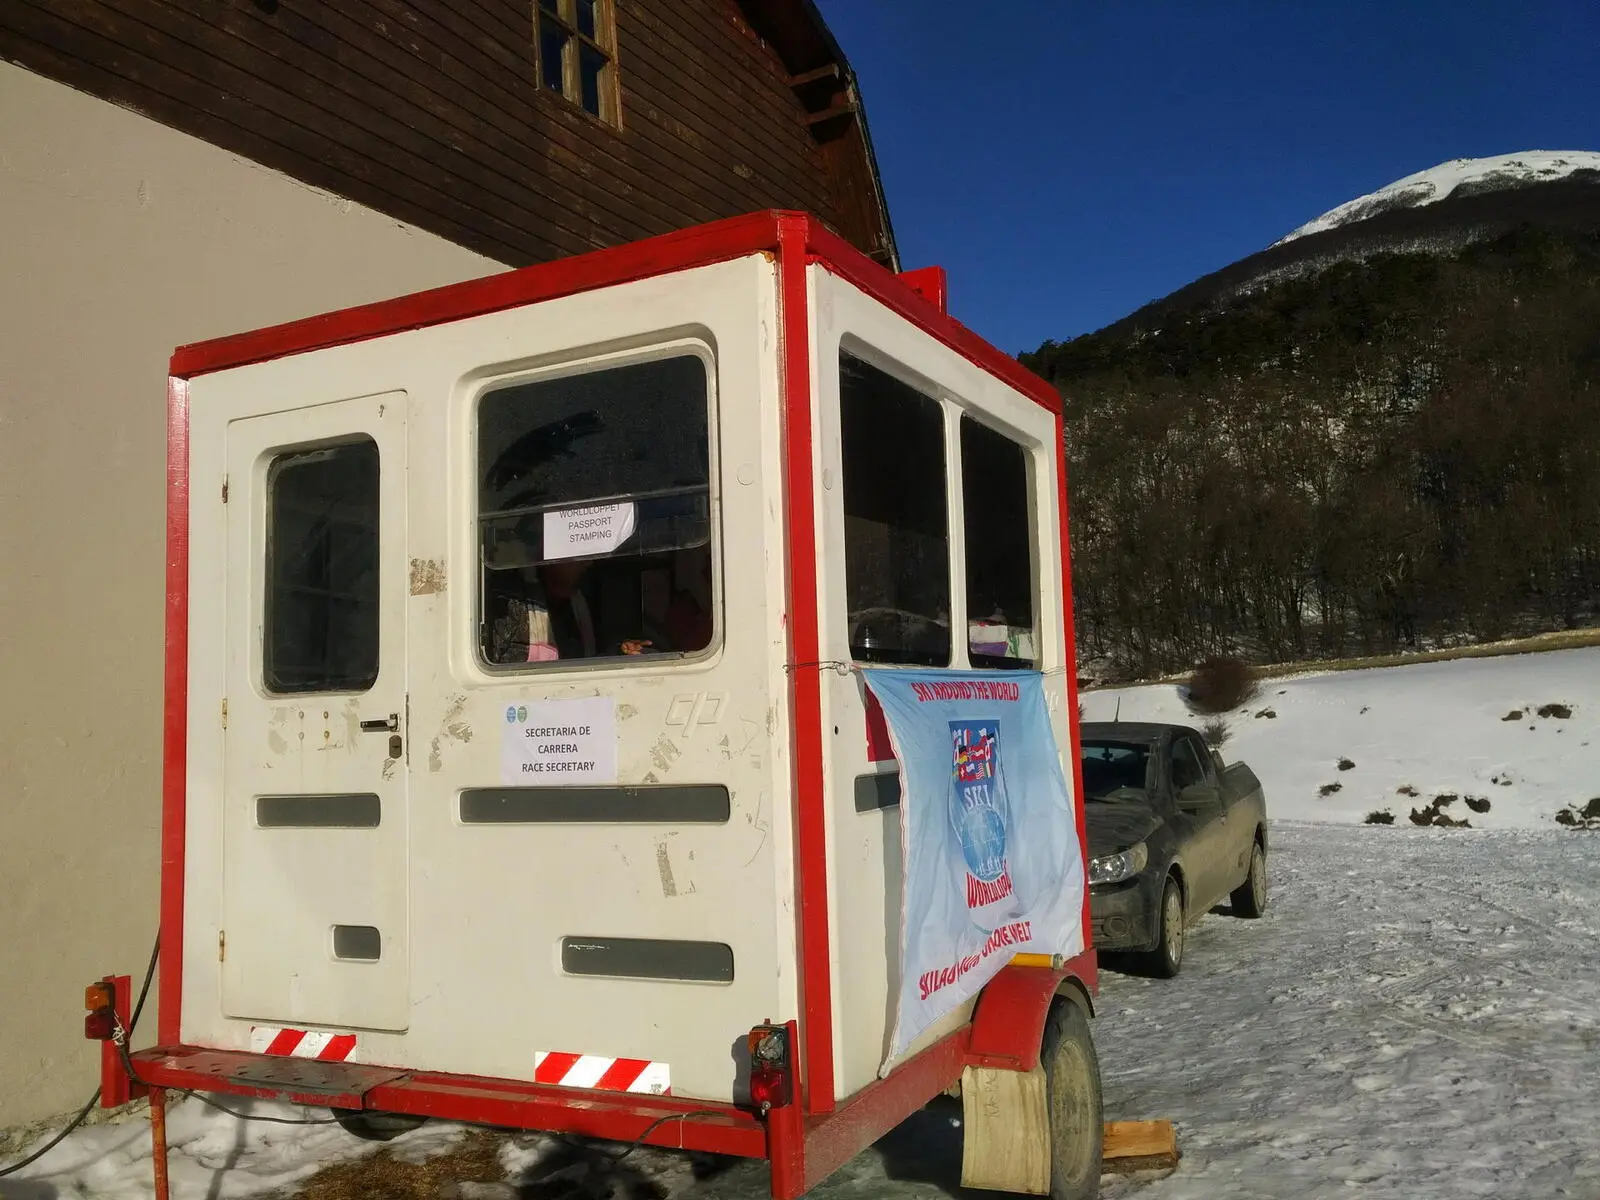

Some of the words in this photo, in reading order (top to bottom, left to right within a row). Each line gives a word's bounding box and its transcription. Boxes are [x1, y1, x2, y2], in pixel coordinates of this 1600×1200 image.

[560, 504, 621, 518] WORLDLOPPET
[568, 517, 612, 530] PASSPORT
[569, 530, 612, 543] STAMPING
[911, 682, 934, 701] SKI
[930, 682, 971, 700] AROUND
[966, 682, 990, 700] THE
[987, 682, 1019, 701] WORLD
[525, 727, 577, 738] SECRETARIA
[579, 726, 591, 736] DE
[538, 744, 578, 754] CARRERA
[522, 763, 544, 772] RACE
[546, 761, 595, 772] SECRETARY
[963, 784, 992, 810] SKI
[1008, 921, 1032, 944] WELT
